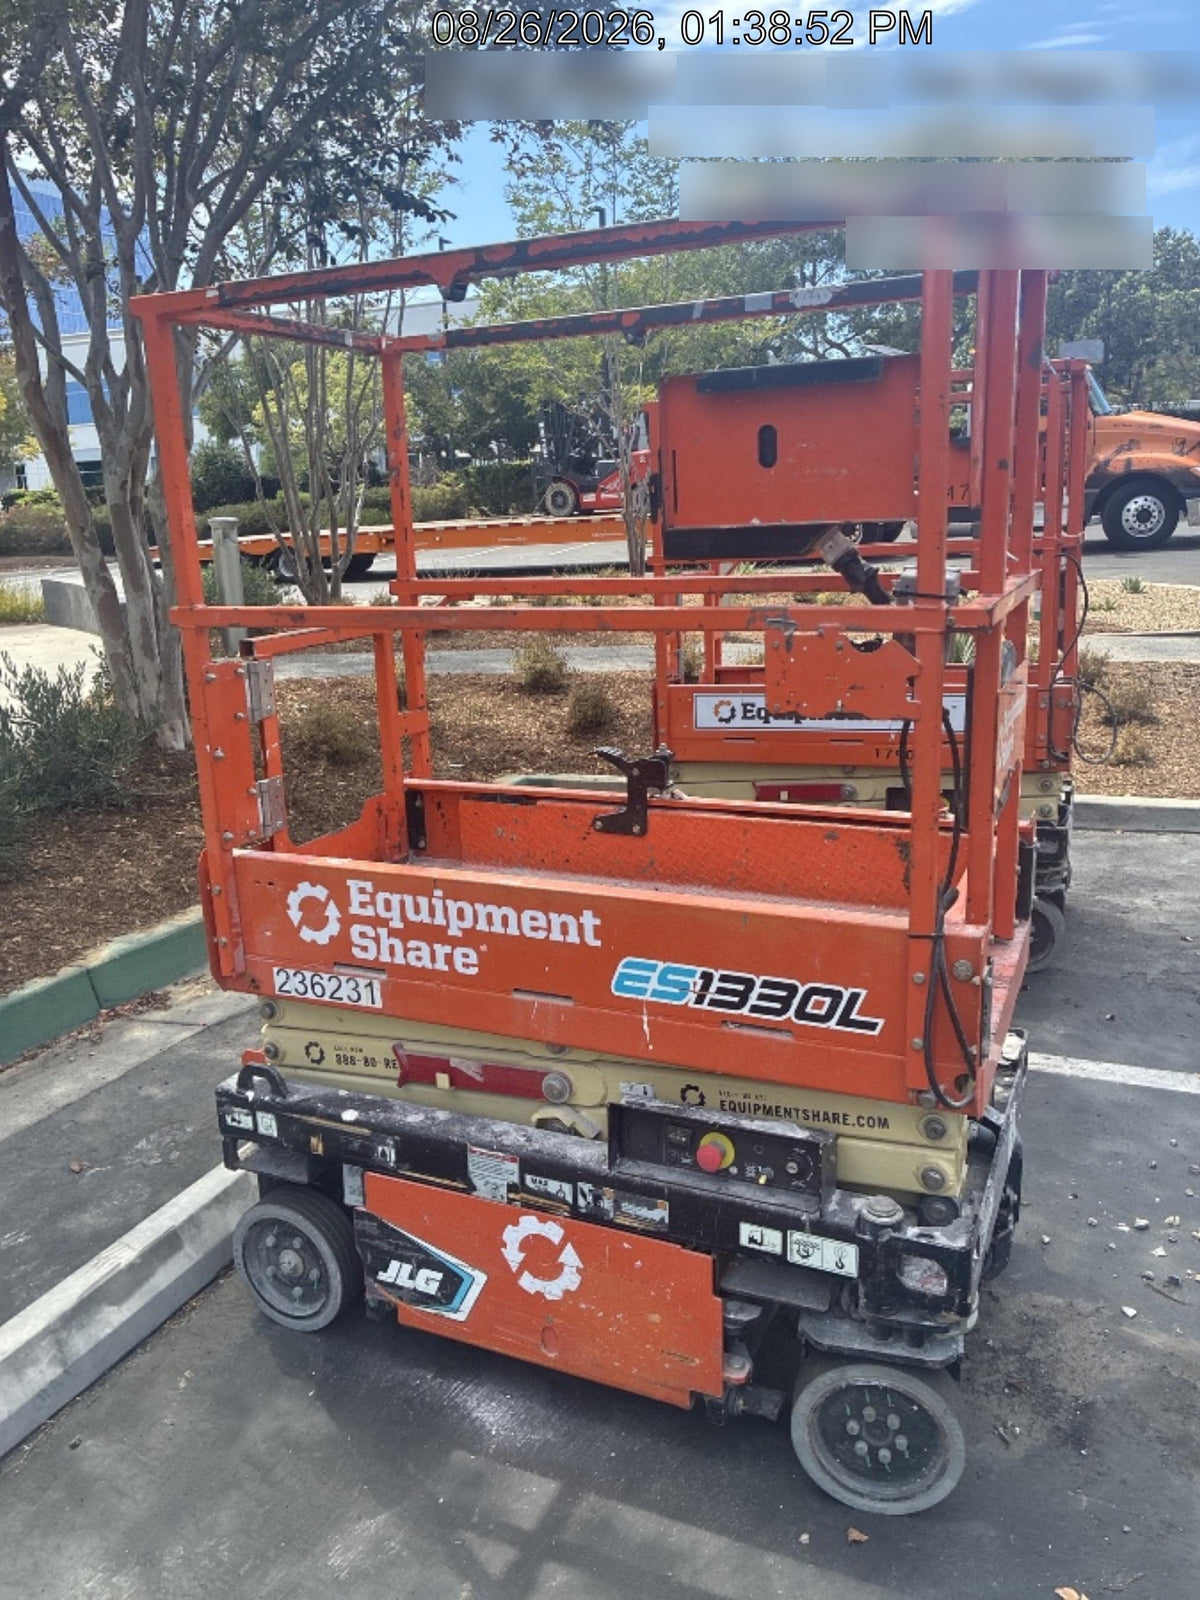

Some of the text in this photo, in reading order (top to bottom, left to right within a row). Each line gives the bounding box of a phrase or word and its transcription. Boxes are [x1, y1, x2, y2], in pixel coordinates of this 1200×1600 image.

[346, 879, 602, 947] Equipment
[350, 924, 479, 975] Share
[275, 967, 378, 1006] 236231
[612, 957, 885, 1035] ES1330L
[720, 1101, 890, 1129] EQUIPMENTSHARE.COM
[377, 1260, 444, 1296] JLG
